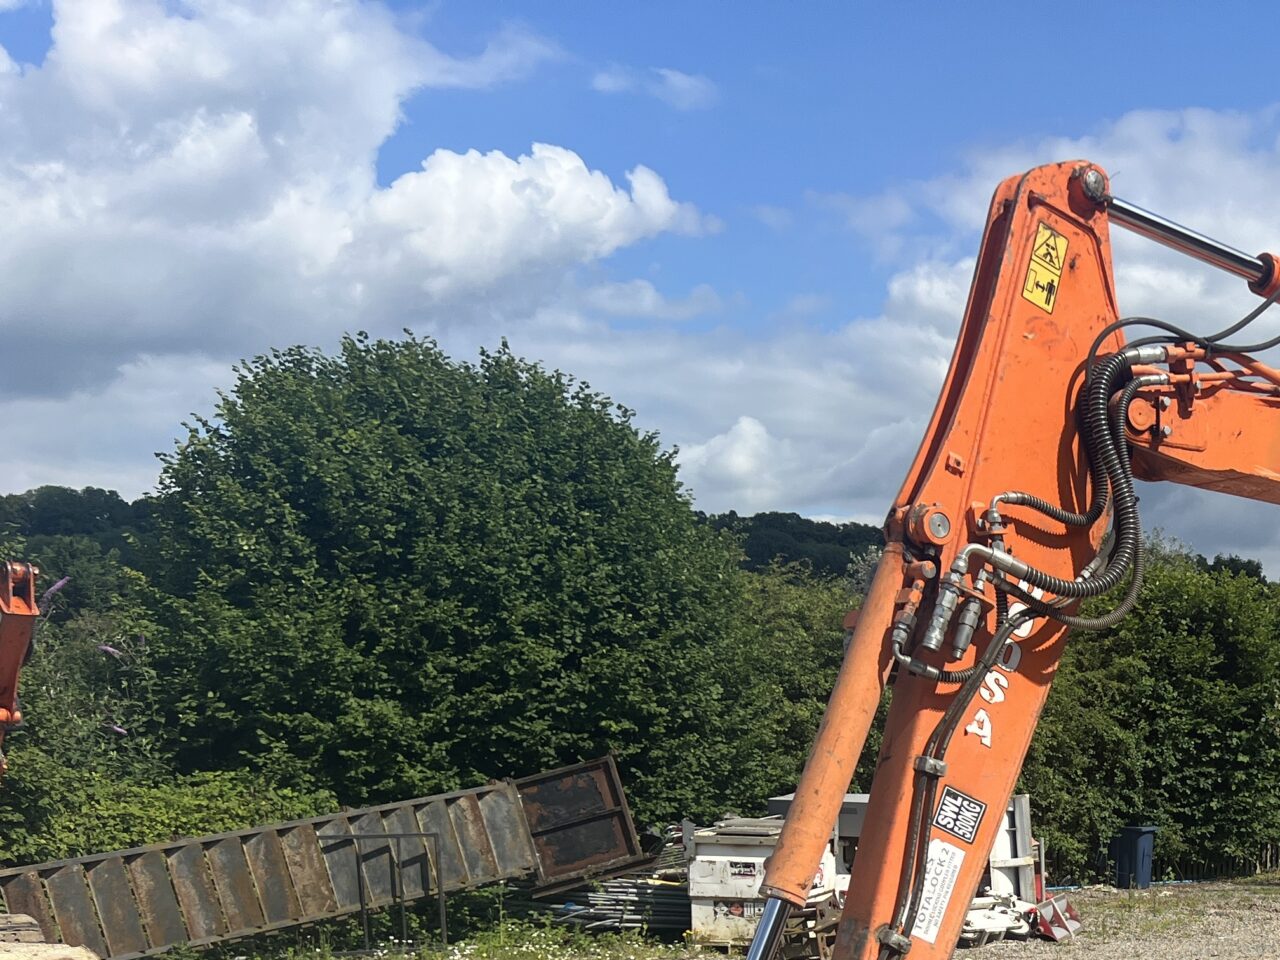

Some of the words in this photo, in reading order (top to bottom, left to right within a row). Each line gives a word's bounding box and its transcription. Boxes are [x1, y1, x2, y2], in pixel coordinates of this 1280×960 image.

[938, 795, 963, 829] SWL
[953, 800, 981, 838] 500KG
[940, 846, 950, 855] 2
